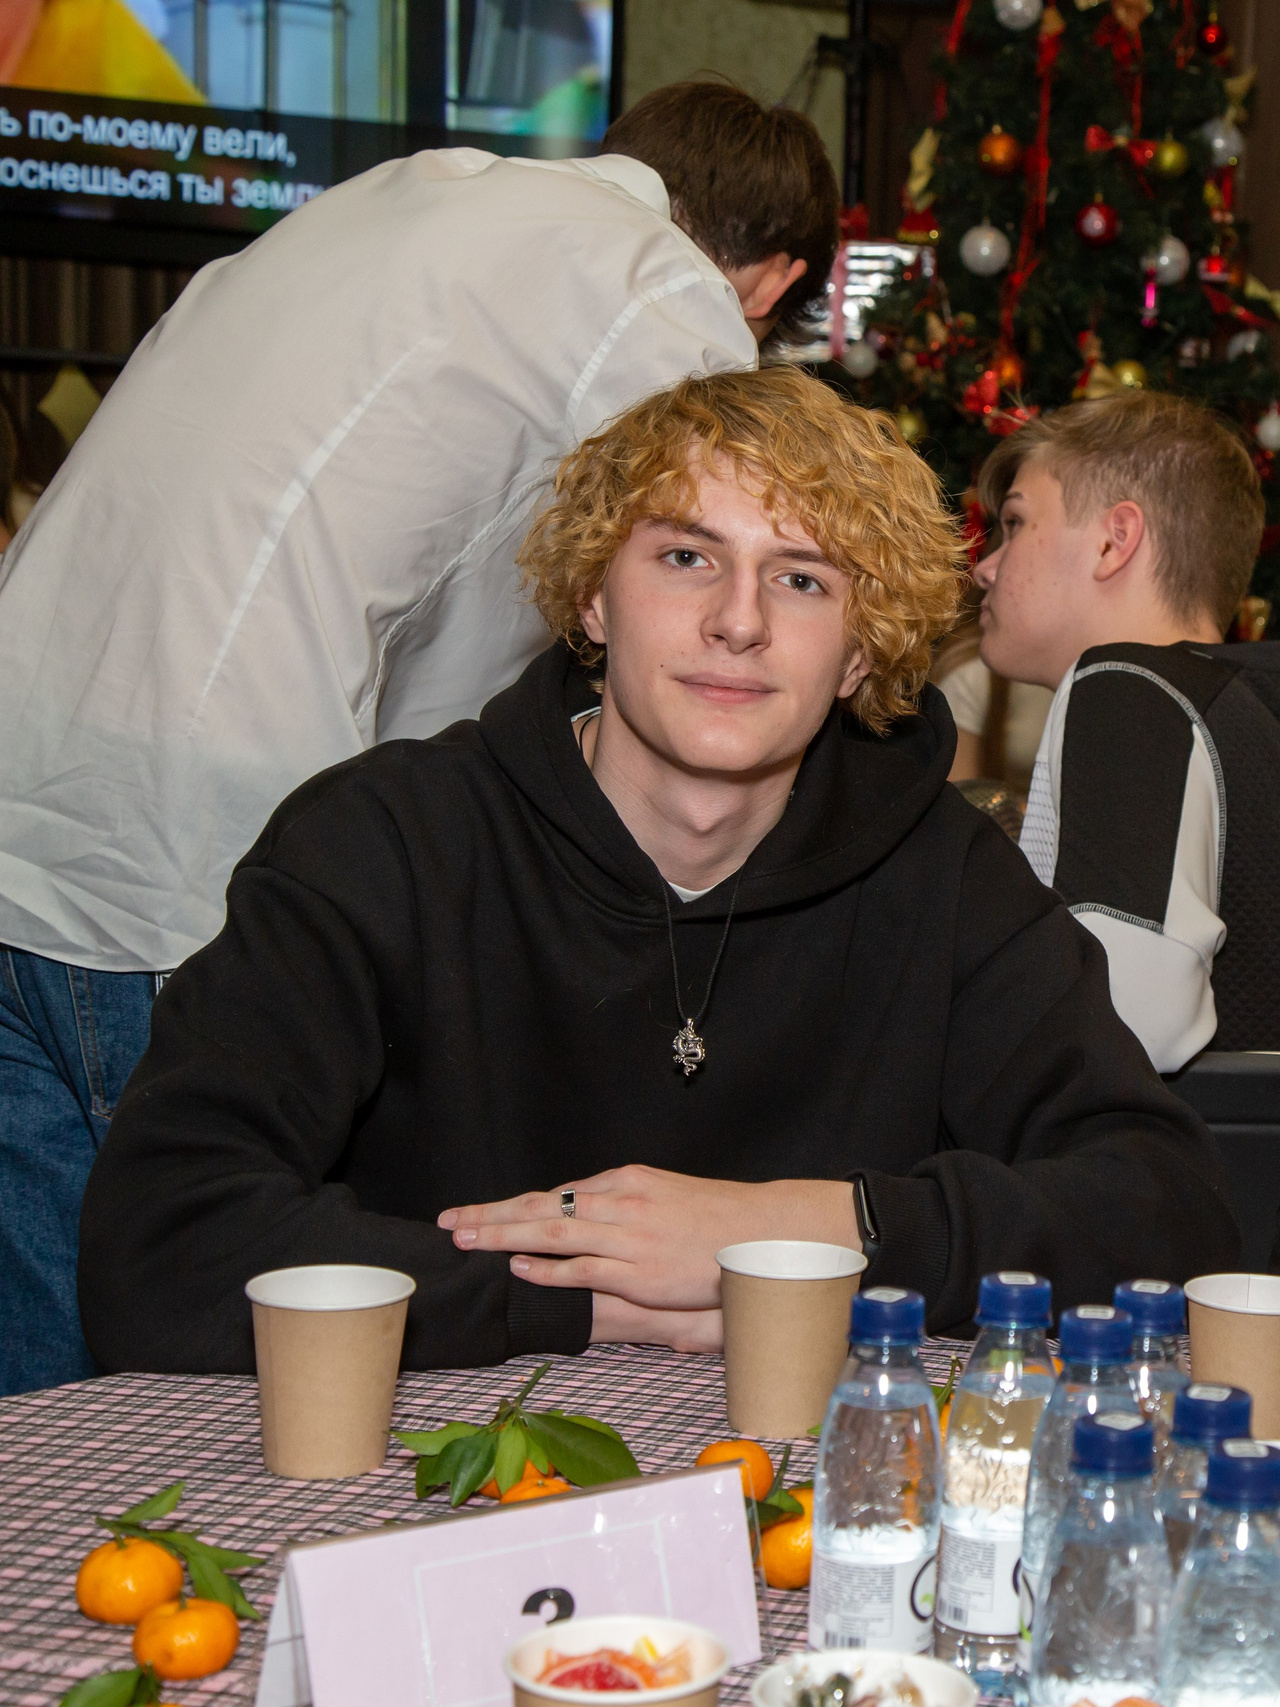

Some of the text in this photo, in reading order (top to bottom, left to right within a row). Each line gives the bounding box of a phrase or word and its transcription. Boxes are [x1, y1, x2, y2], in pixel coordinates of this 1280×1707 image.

[27, 109, 198, 162] по-моему
[202, 125, 297, 168] вели,
[0, 156, 171, 200] оснешься
[176, 172, 225, 206] ты
